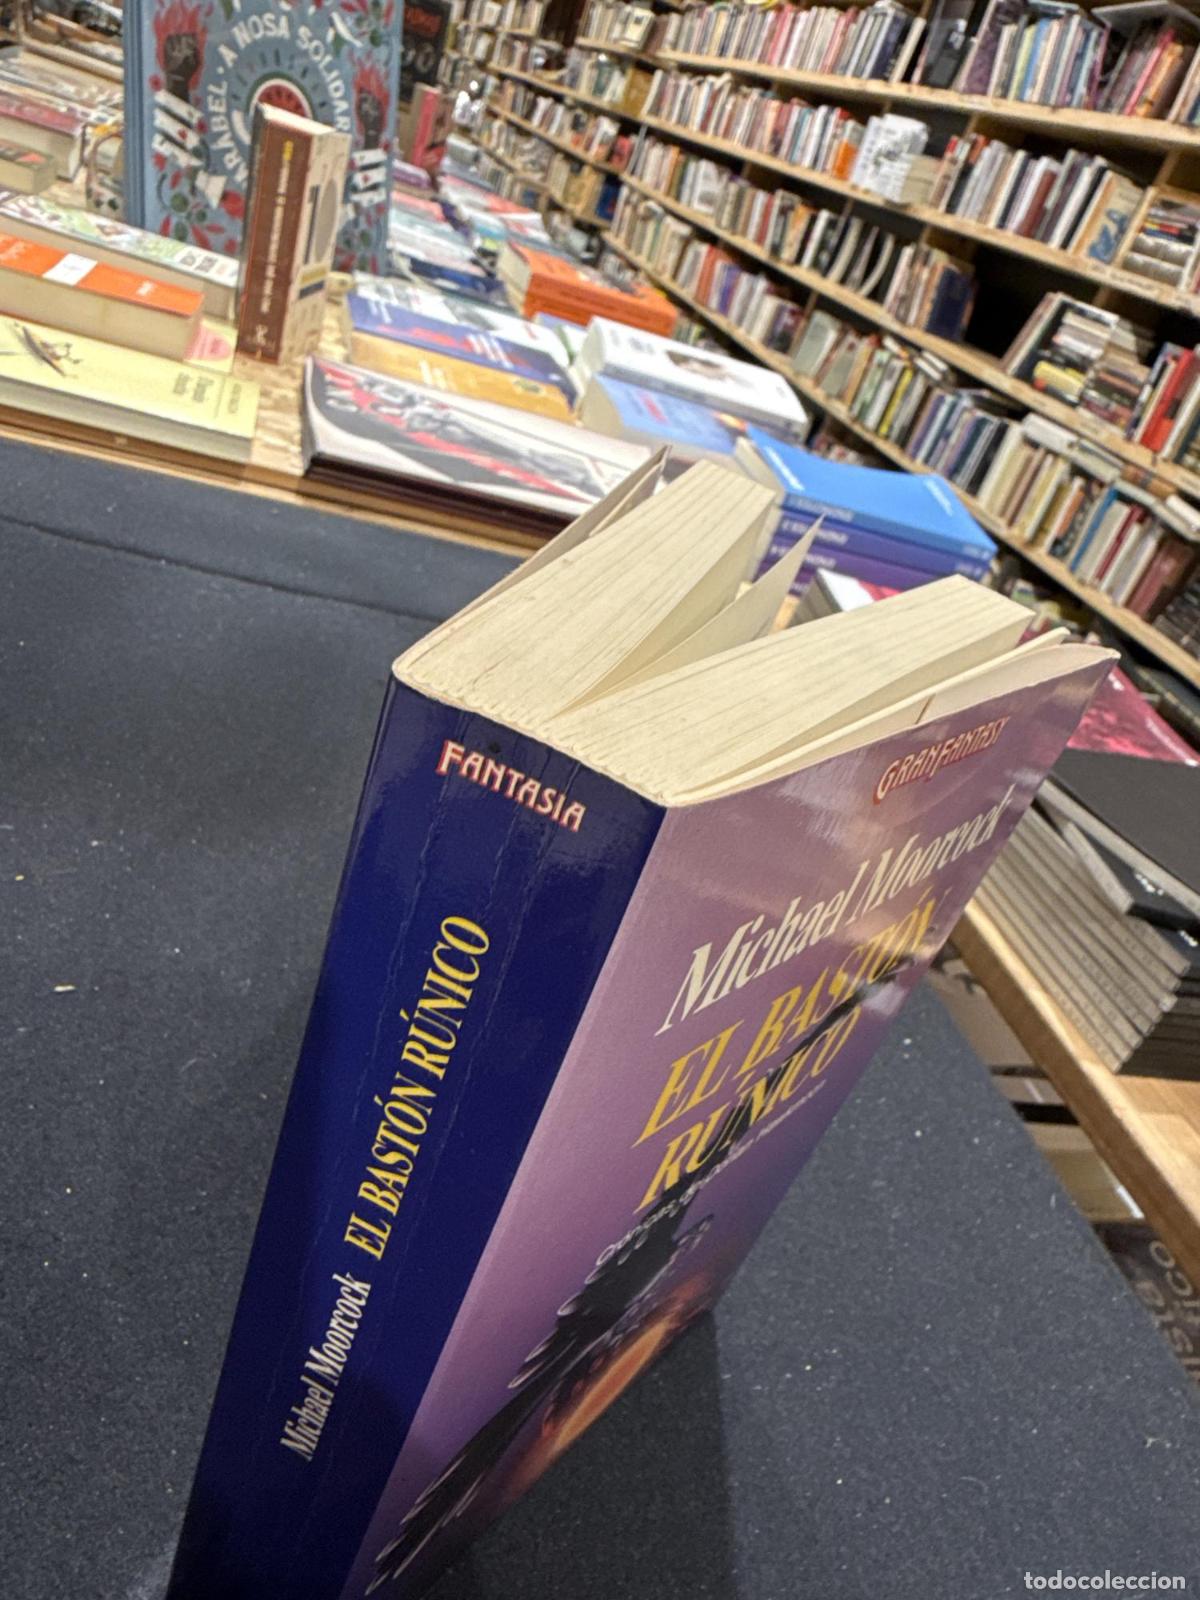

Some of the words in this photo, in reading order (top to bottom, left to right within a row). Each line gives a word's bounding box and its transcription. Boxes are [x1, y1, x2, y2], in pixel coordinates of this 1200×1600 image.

[217, 44, 238, 68] A
[232, 12, 290, 48] NOSA
[436, 740, 586, 832] FANTASIA
[655, 860, 870, 1037] Michael
[845, 784, 1016, 926] Moorcock
[400, 916, 490, 1080] RÚNICO
[632, 1019, 745, 1148] EL
[358, 1072, 437, 1216] BASTÓN
[344, 1212, 392, 1260] EL
[304, 1271, 371, 1386] Moorcock
[280, 1373, 335, 1461] Michael
